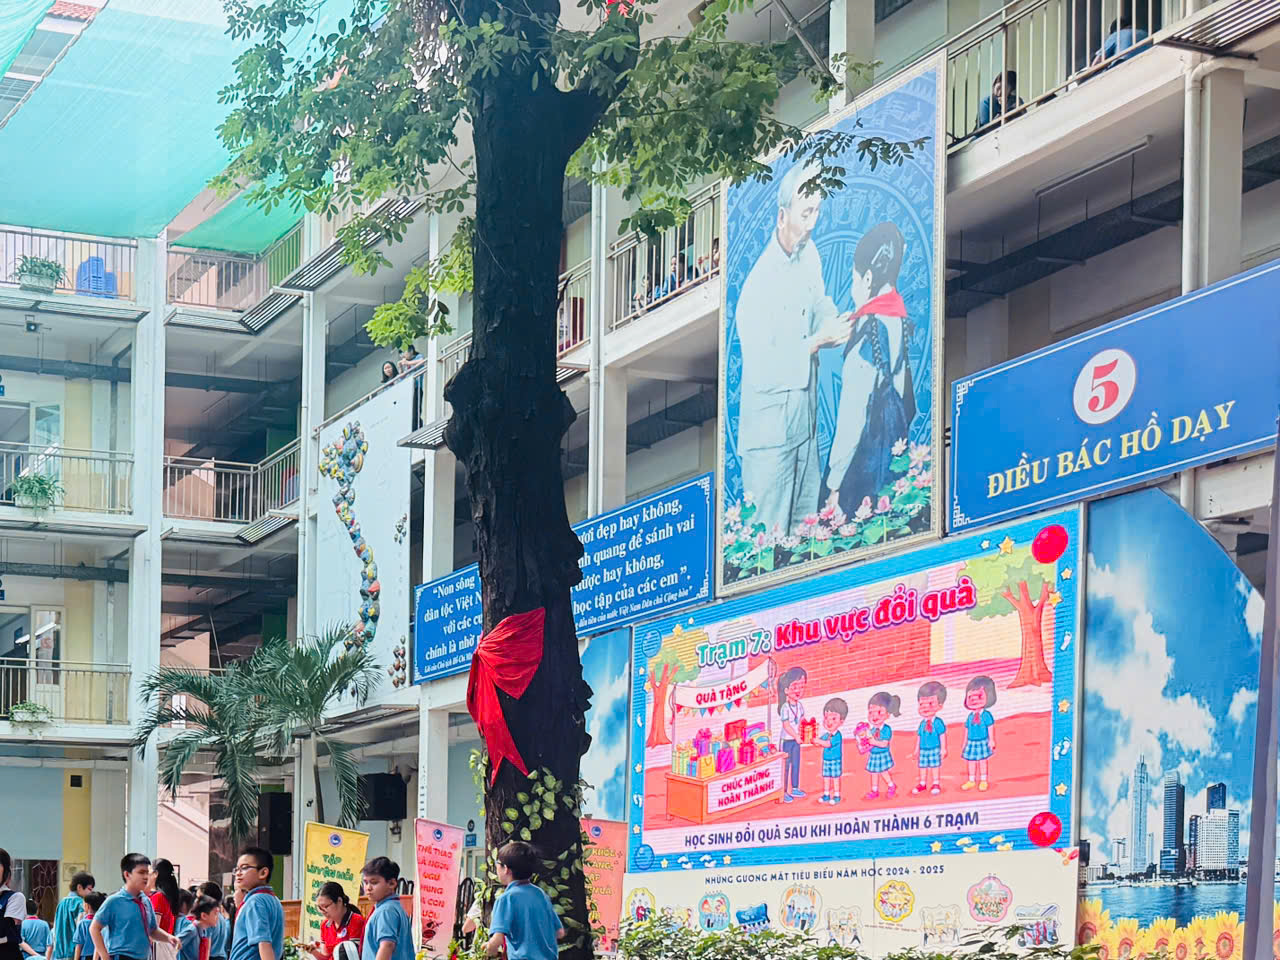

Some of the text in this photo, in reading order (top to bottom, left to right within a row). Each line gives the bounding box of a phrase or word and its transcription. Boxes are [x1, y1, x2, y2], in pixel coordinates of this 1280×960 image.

[1088, 359, 1119, 412] 5
[987, 400, 1236, 498] ĐIỀU BÁC HỒ DẠY
[578, 499, 683, 545] ươi đẹp hay không,
[593, 542, 626, 566] quang
[628, 529, 644, 551] để
[645, 522, 673, 545] sánh
[676, 513, 695, 534] vai
[455, 576, 475, 590] sông
[603, 566, 623, 584] hay
[625, 553, 664, 576] không,
[424, 608, 439, 622] dân
[440, 603, 453, 617] tộc
[455, 594, 473, 611] Việt
[573, 600, 592, 616] học
[594, 592, 613, 610] tập
[614, 583, 635, 602] của
[637, 577, 657, 595] các
[443, 620, 455, 635] với
[457, 615, 472, 631] các
[697, 576, 976, 667] Trạm 7: Khu vực đổi quà
[425, 643, 447, 660] chính
[449, 640, 456, 653] là
[458, 634, 475, 650] nhờ
[696, 680, 747, 705] QUÀ TẶNG
[718, 779, 775, 807] HOÀN THÀNH!
[721, 768, 770, 793] CHÚC MỪNG
[684, 811, 979, 850] HỌC SINH ĐỔI QUÀ SAU KHI HOÀN THÀNH 6 TRẠM
[886, 866, 910, 876] 2024
[920, 865, 944, 875] 2025
